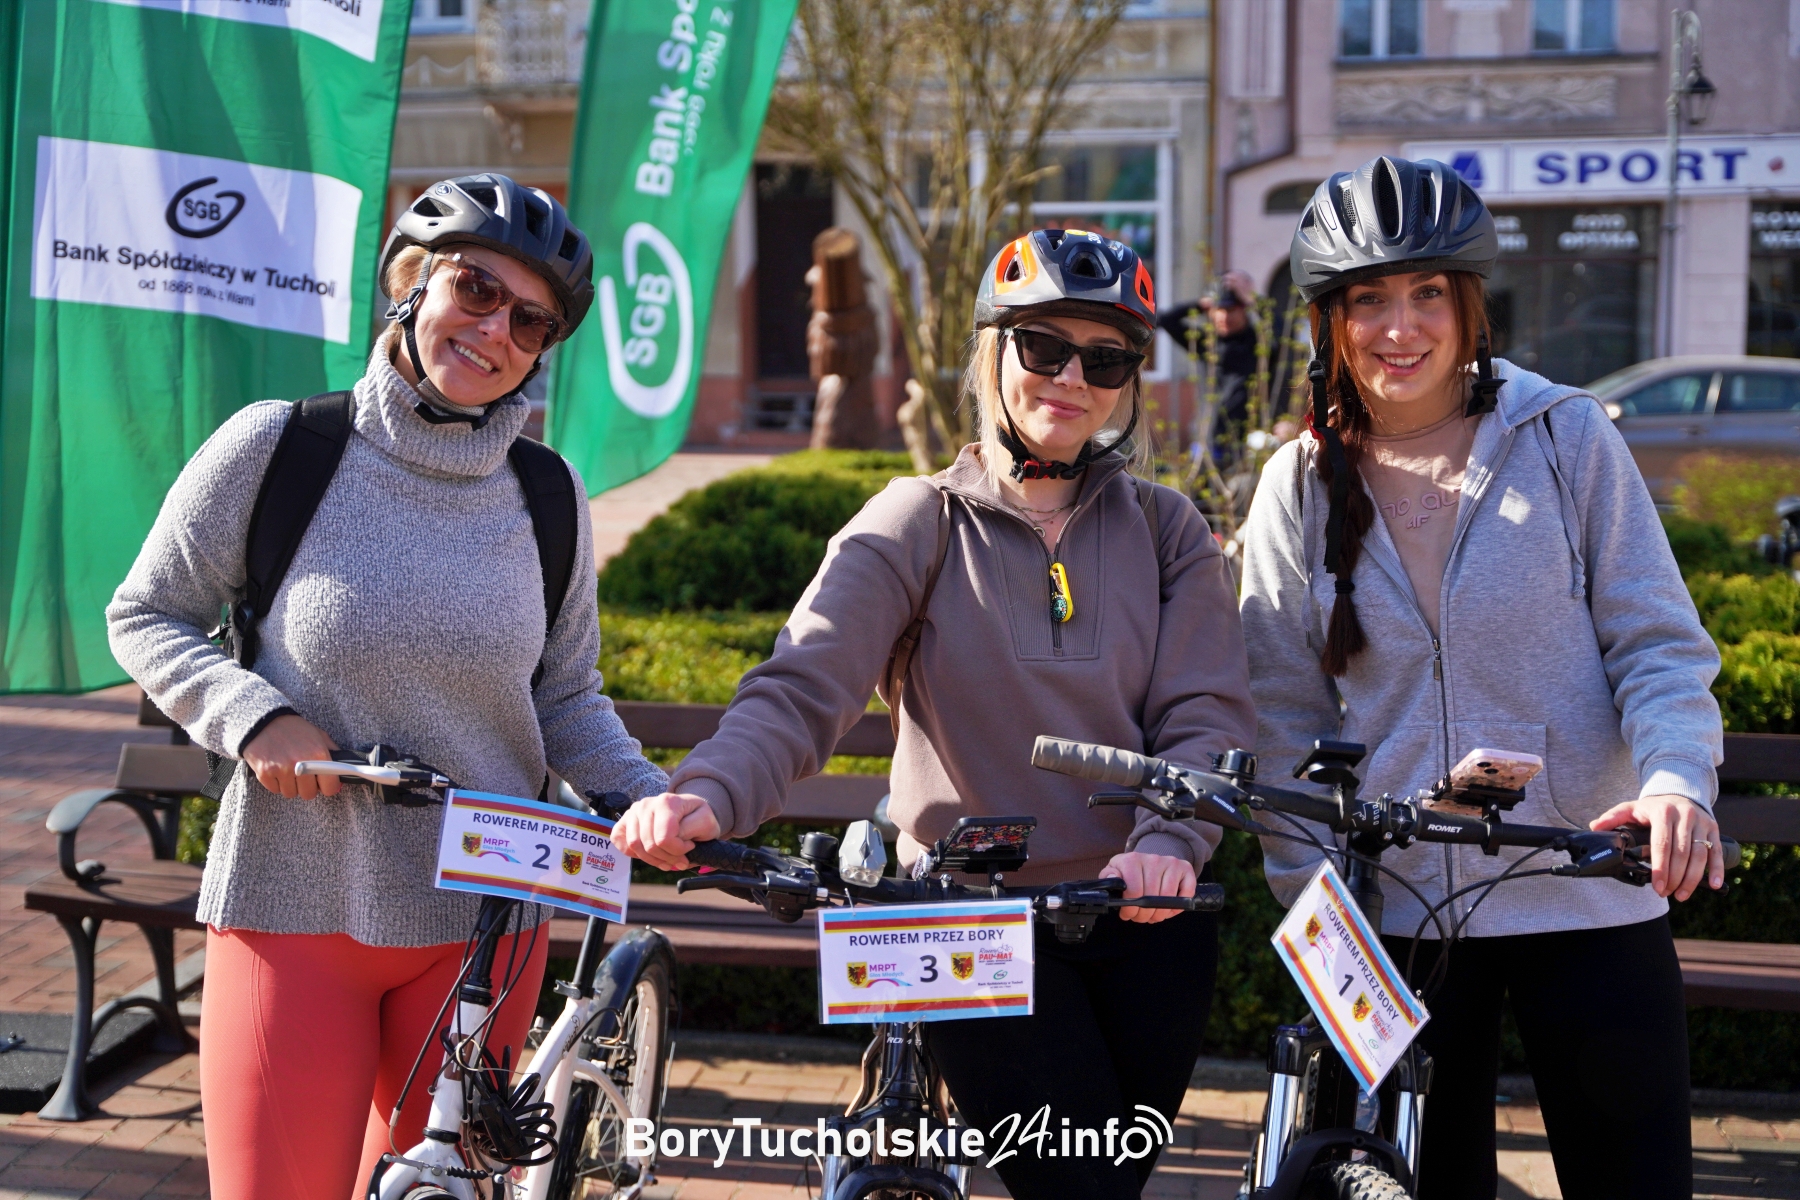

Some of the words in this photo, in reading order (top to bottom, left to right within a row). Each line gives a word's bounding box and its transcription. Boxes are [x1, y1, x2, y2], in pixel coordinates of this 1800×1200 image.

[692, 30, 727, 90] roku
[635, 83, 689, 197] Bank
[1536, 147, 1748, 185] SPORT
[183, 197, 221, 221] SGB
[53, 239, 109, 263] Bank
[241, 267, 257, 283] w
[264, 267, 336, 298] Tucholi
[138, 278, 156, 291] od
[162, 280, 194, 294] 1868
[623, 272, 674, 369] SGB
[1212, 794, 1236, 814] SHIMANO
[473, 812, 539, 832] ROWEREM
[541, 824, 578, 841] PRZEZ
[580, 833, 612, 850] BORY
[1427, 823, 1463, 835] ROMET
[483, 837, 510, 848] MRPT
[532, 843, 551, 871] 2
[849, 932, 920, 947] ROWEREM
[924, 930, 965, 943] PRZEZ
[968, 929, 1005, 942] BORY
[1319, 931, 1336, 955] MRPT
[869, 963, 897, 973] MRPT
[978, 952, 1013, 961] PAU-MAT
[1323, 902, 1359, 959] ROWEREM
[1357, 958, 1380, 994] PRZEZ
[1376, 989, 1400, 1021] BORY
[919, 954, 939, 984] 3
[1338, 974, 1355, 997] 1
